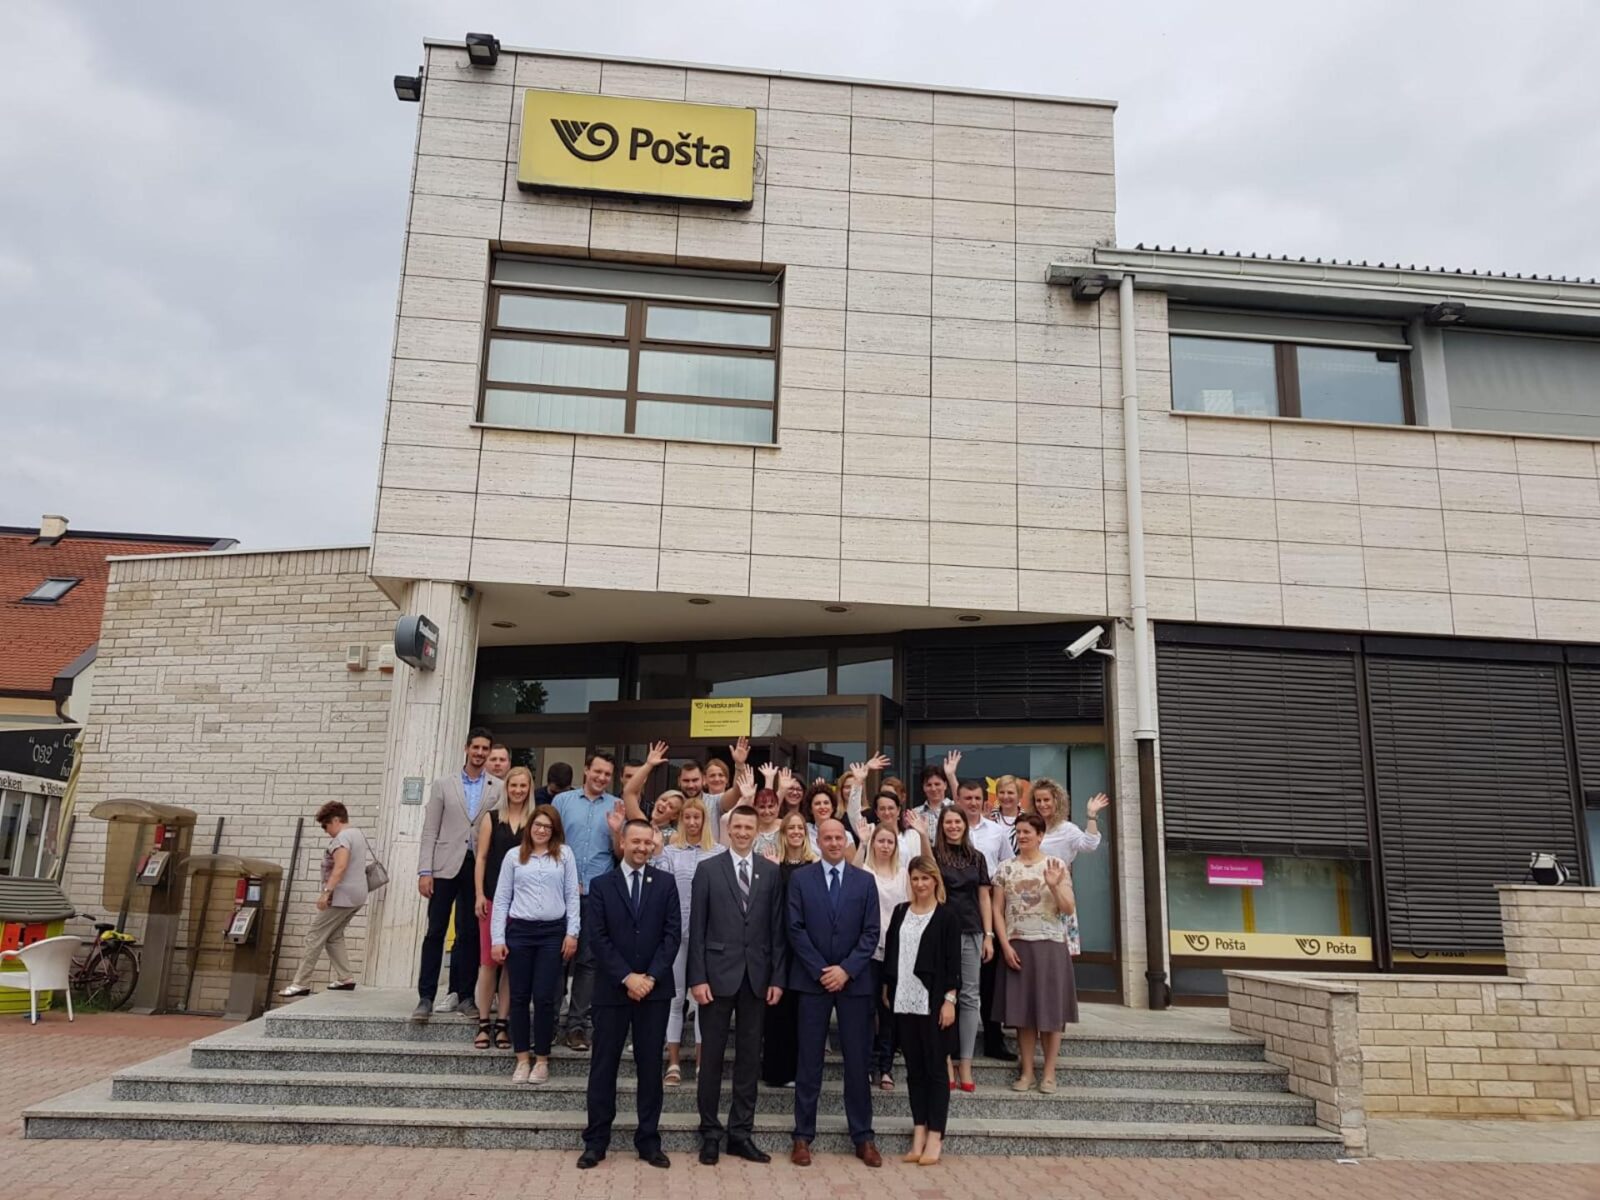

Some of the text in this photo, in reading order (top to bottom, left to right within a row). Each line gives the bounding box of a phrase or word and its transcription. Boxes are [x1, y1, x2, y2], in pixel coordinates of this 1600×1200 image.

[629, 127, 731, 170] Pošta
[1215, 937, 1246, 951] Pošta
[1326, 941, 1357, 955] Pošta
